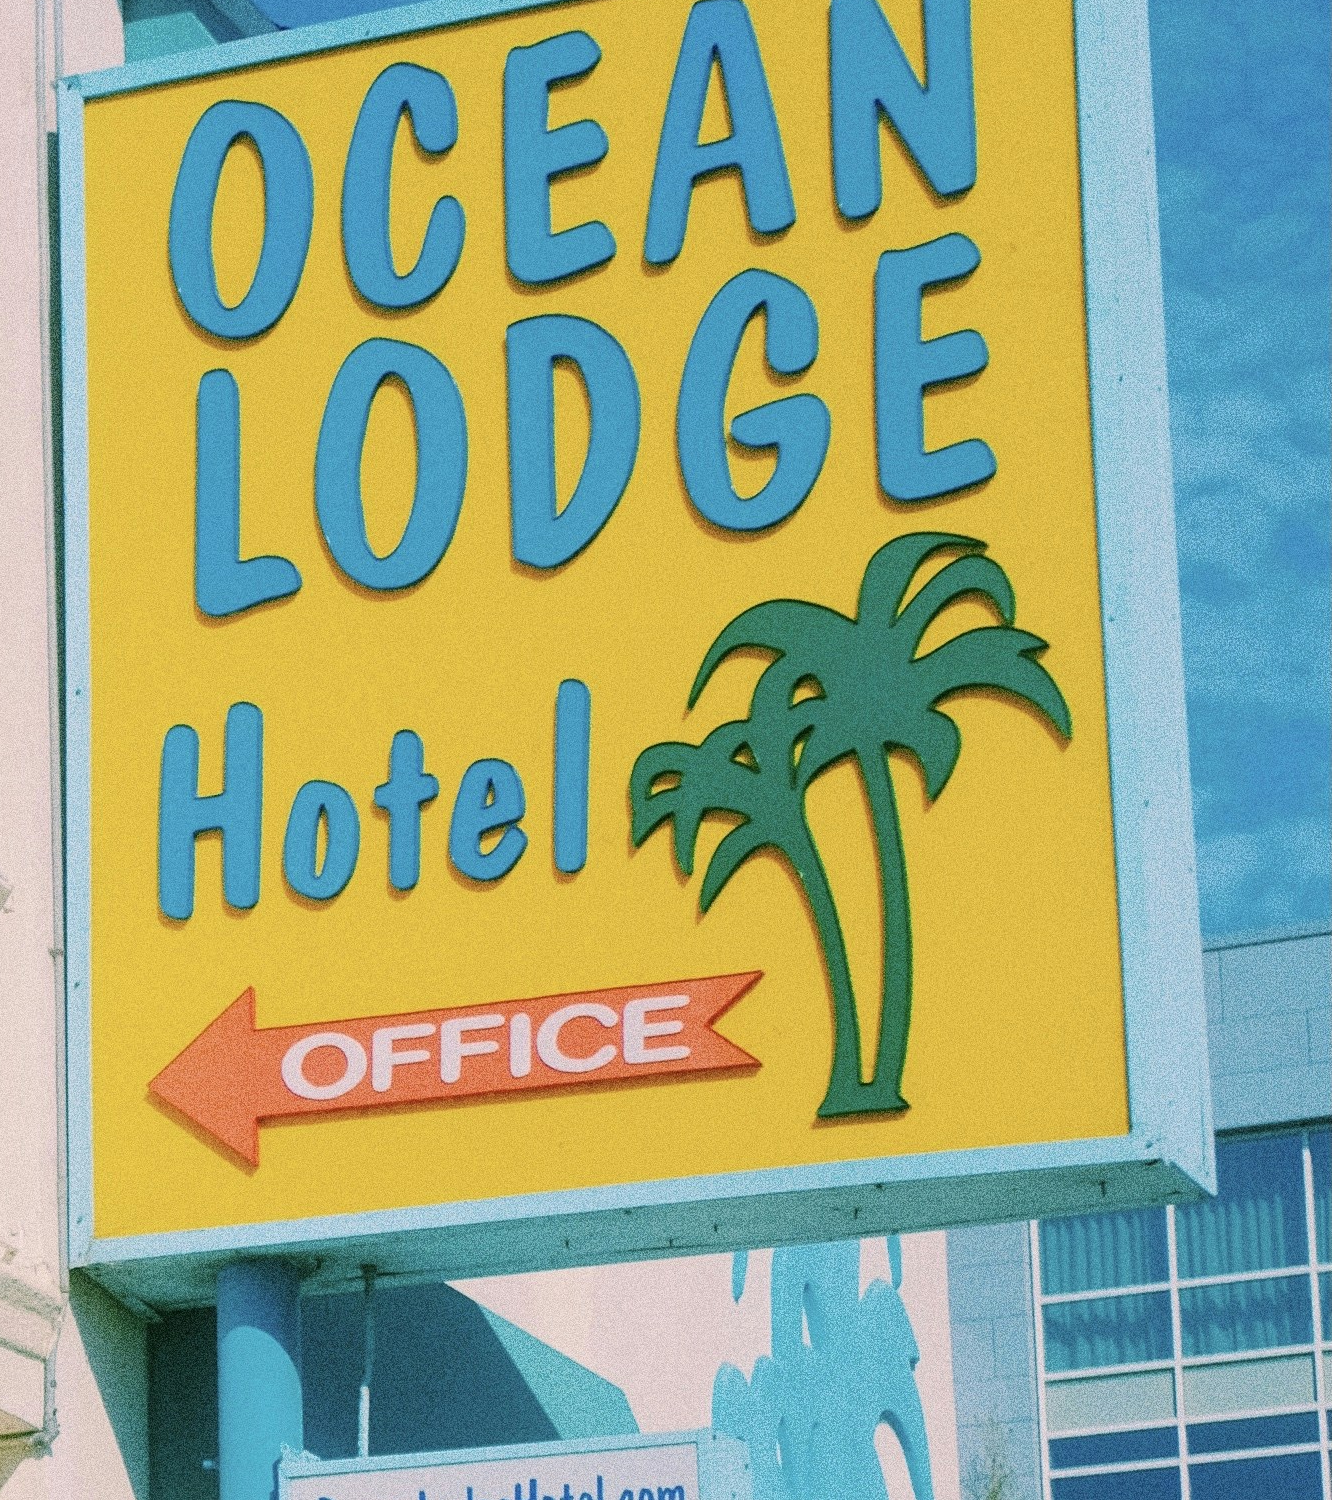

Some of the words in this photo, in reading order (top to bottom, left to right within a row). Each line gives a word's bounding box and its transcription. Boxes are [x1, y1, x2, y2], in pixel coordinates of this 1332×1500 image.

[193, 231, 999, 619] LODGE
[157, 677, 593, 922] Hotel
[279, 993, 694, 1101] OFFICE
